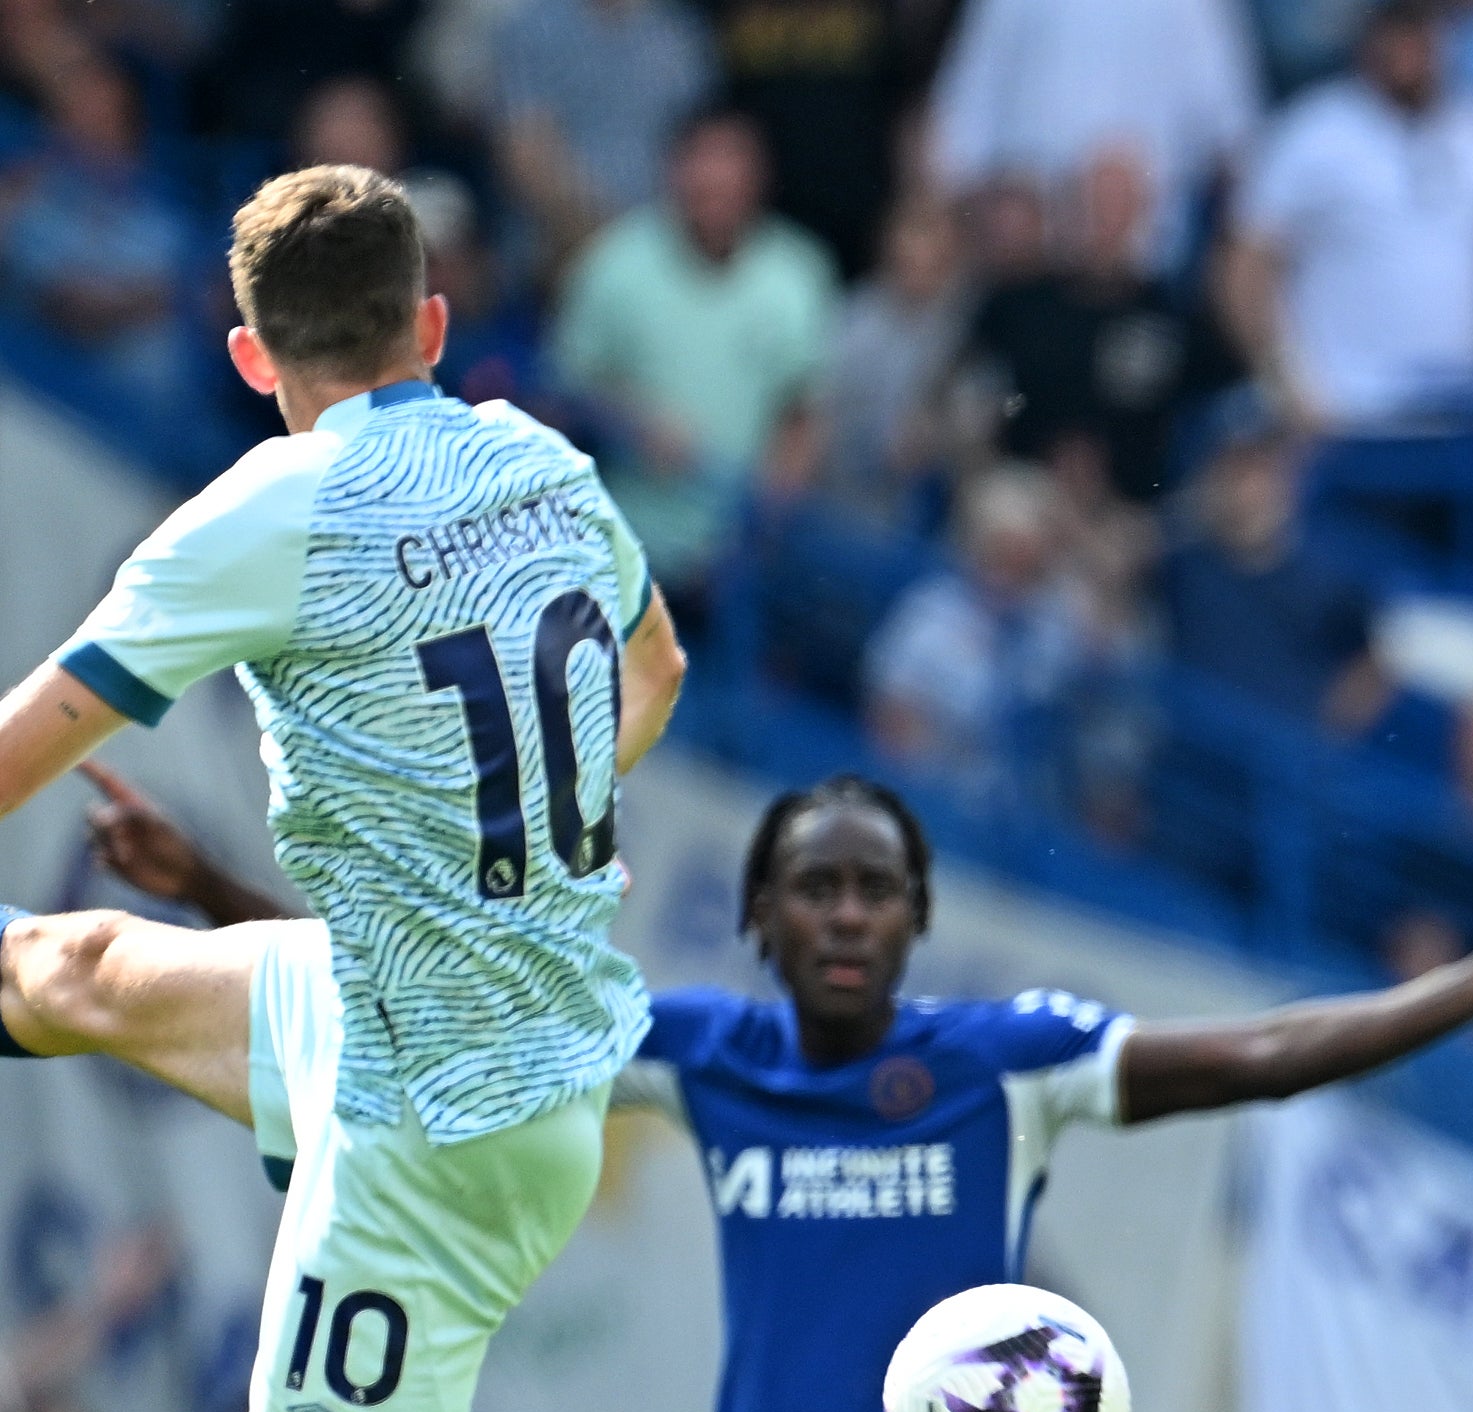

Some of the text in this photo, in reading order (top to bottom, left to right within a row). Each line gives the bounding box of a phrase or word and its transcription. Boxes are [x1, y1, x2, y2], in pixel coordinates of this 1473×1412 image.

[415, 590, 622, 899] 10
[777, 1181, 954, 1219] ATHLETE
[781, 1143, 953, 1179] INFINITE
[286, 1274, 408, 1408] 10
